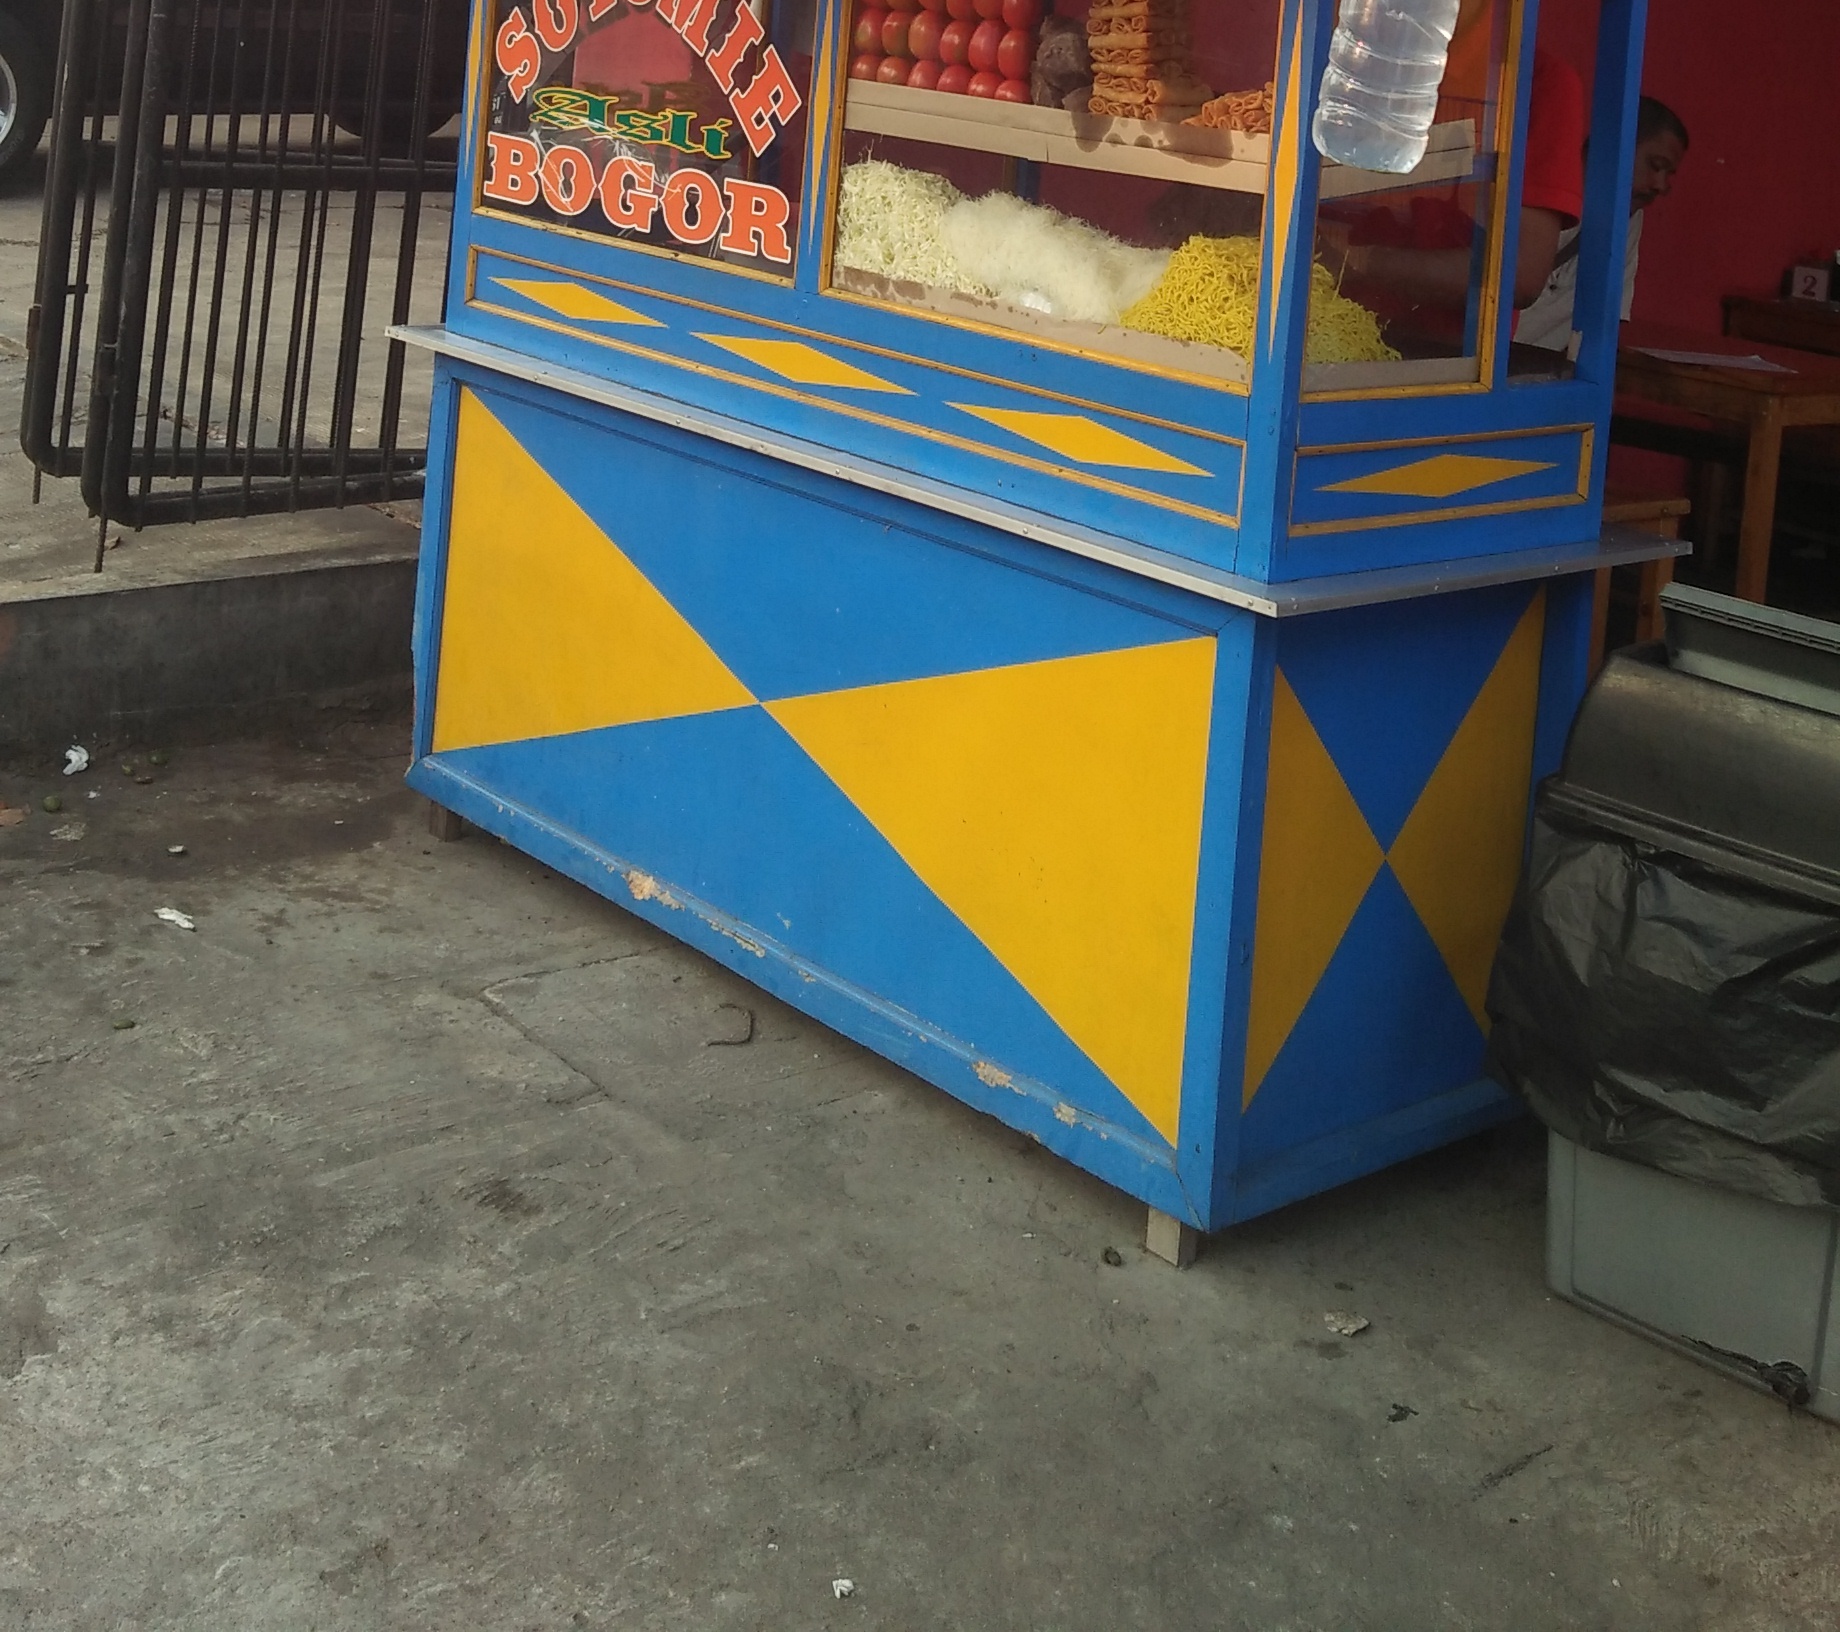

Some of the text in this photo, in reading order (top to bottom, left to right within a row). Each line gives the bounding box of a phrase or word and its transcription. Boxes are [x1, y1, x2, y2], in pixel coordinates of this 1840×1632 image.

[529, 86, 733, 160] Asli
[484, 131, 792, 264] BOGOR
[1802, 275, 1818, 298] 2
